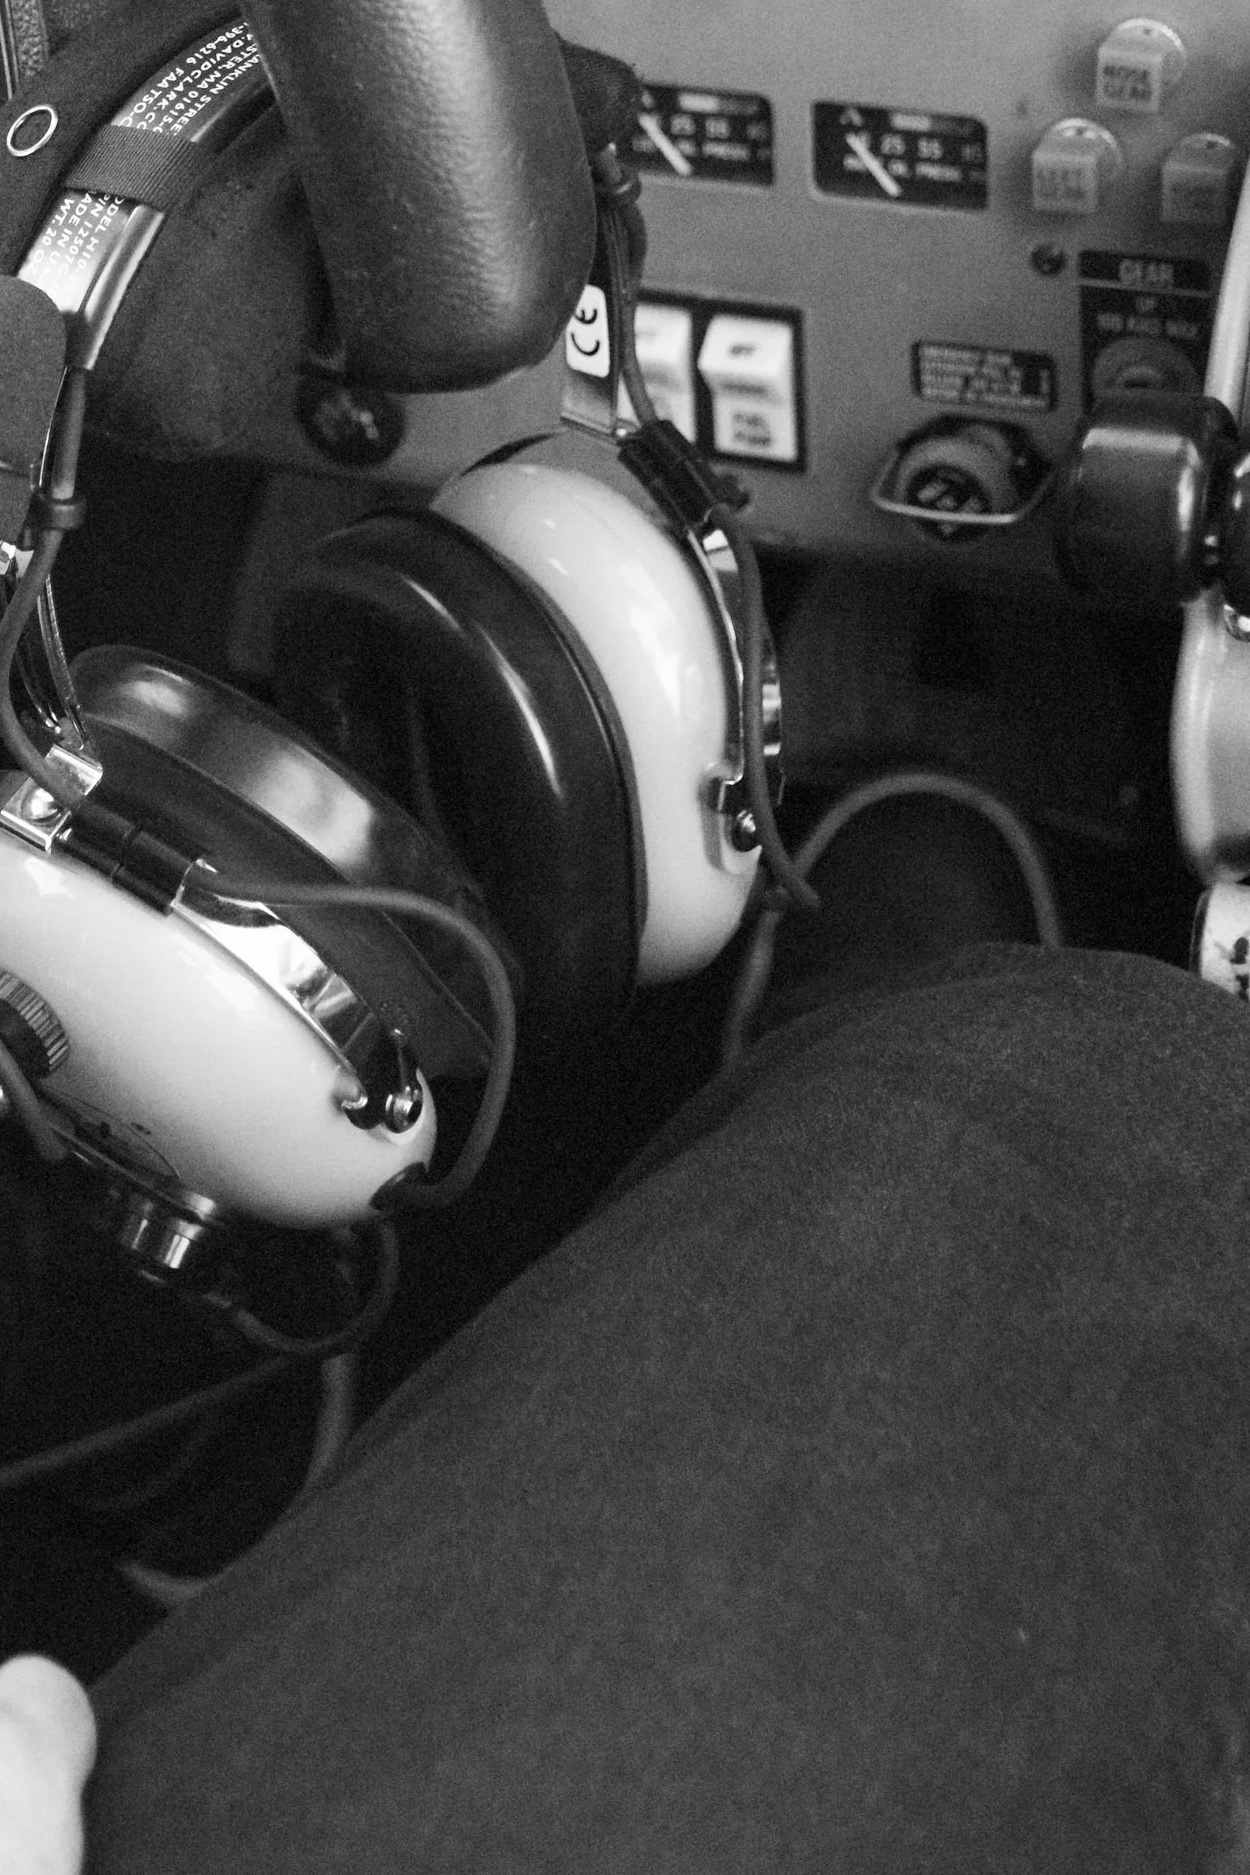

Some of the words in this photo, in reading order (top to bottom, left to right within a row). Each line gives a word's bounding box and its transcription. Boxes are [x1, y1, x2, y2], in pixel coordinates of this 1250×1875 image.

[157, 67, 185, 89] FAA
[197, 70, 221, 89] MA
[170, 94, 212, 136] STREE
[51, 198, 75, 226] WT.
[67, 190, 98, 226] ADE
[42, 227, 57, 246] 20
[57, 228, 73, 248] IN
[570, 308, 601, 357] CE
